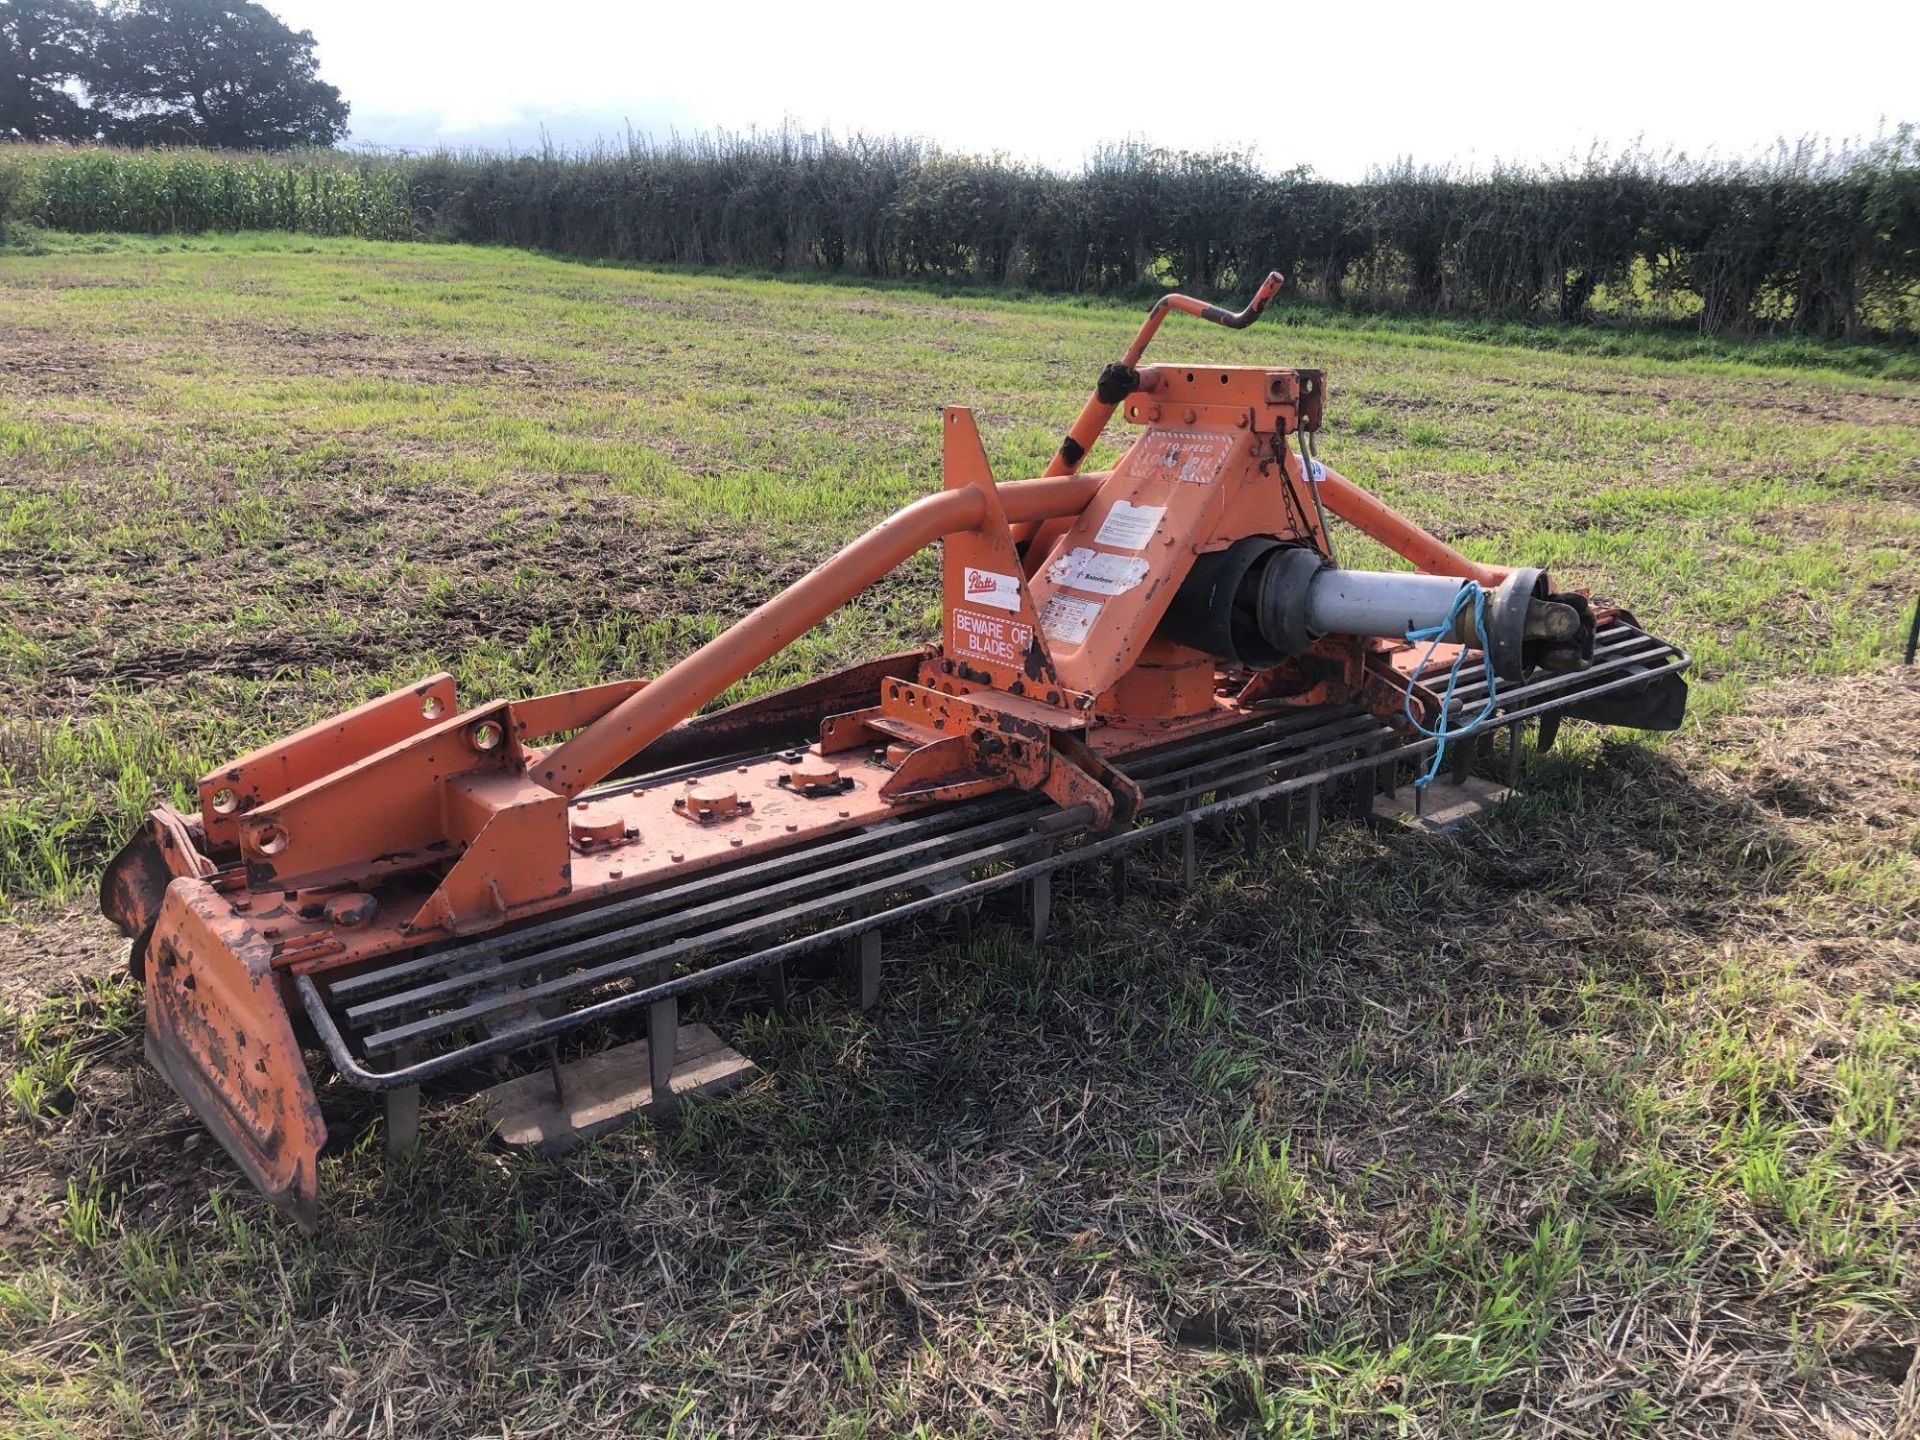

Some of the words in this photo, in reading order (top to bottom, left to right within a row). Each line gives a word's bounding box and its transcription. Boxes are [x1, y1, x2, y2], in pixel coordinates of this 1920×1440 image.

[1182, 444, 1213, 453] SPEED
[957, 614, 1004, 638] BEWARE
[1011, 627, 1028, 645] OF
[969, 634, 1014, 660] BLADES
